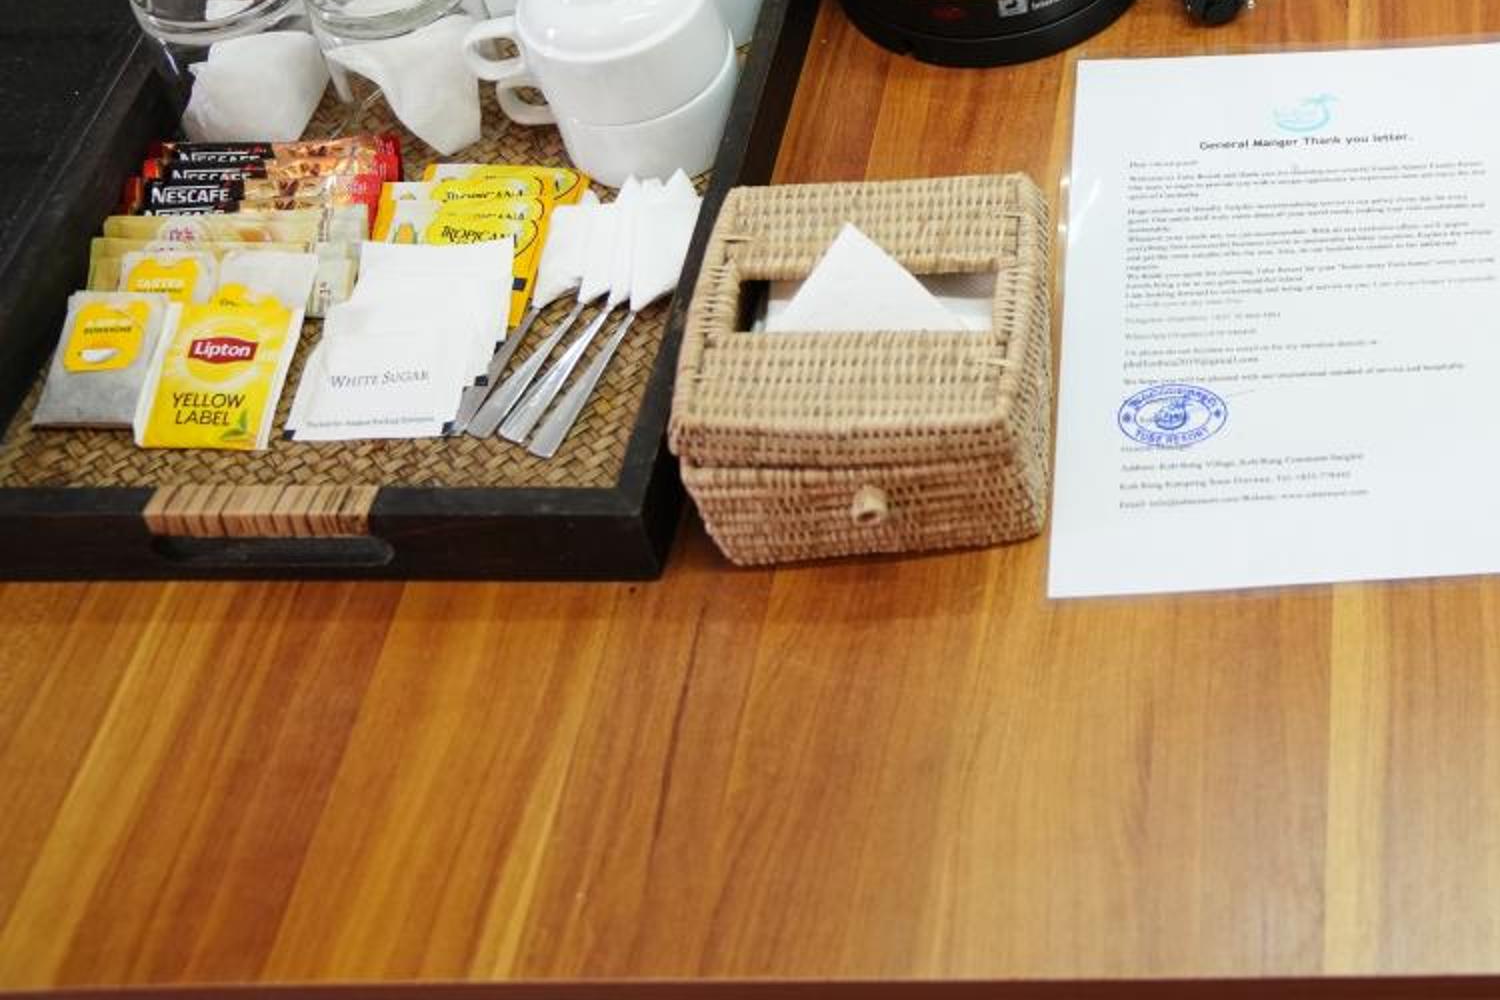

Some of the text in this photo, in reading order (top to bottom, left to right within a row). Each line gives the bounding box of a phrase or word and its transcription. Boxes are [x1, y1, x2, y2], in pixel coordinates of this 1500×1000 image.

[1199, 138, 1249, 151] General
[1303, 135, 1342, 146] Thank
[1345, 136, 1369, 146] you
[193, 336, 251, 358] Lipton
[331, 374, 379, 388] WHITE
[172, 393, 247, 409] YELLOW
[175, 409, 231, 427] LABEL
